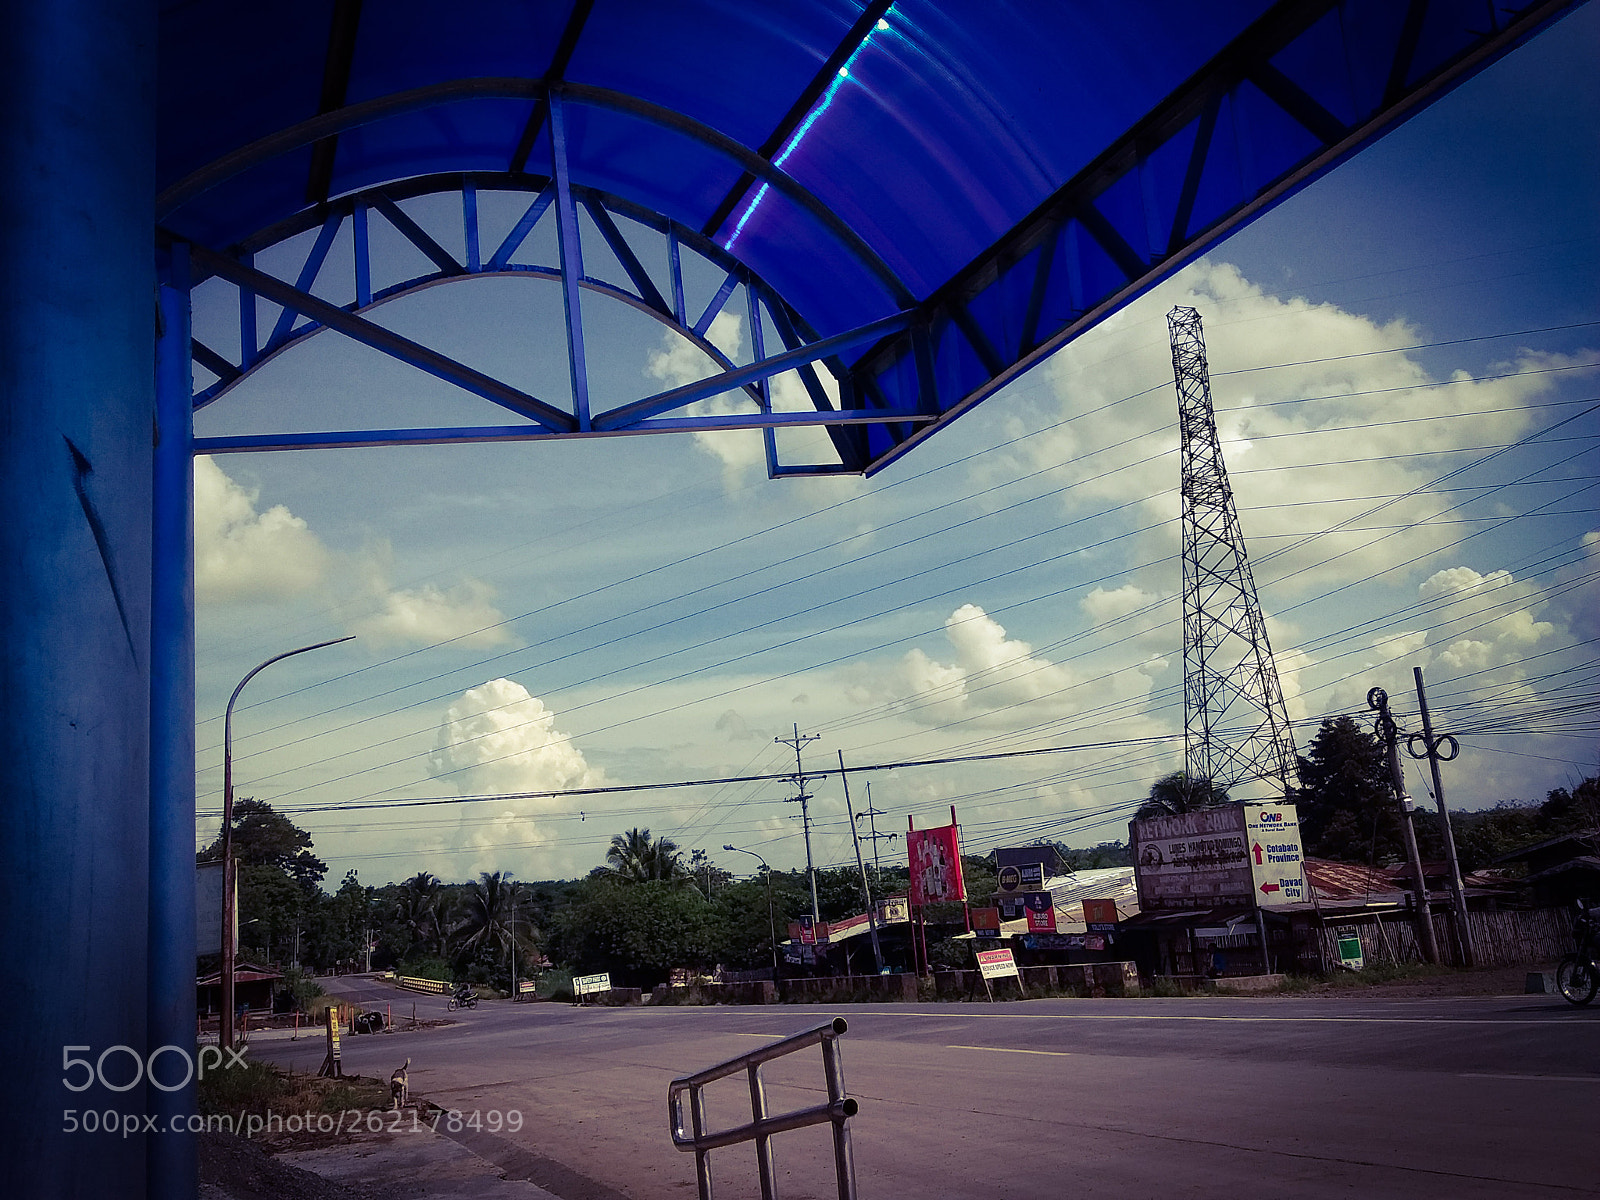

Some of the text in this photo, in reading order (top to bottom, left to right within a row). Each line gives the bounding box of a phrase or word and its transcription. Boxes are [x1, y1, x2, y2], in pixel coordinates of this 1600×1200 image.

[1260, 812, 1282, 822] ONB
[1266, 843, 1299, 853] Cotabato
[1267, 853, 1300, 863] Province
[1279, 878, 1303, 887] Davao
[1285, 888, 1301, 898] City
